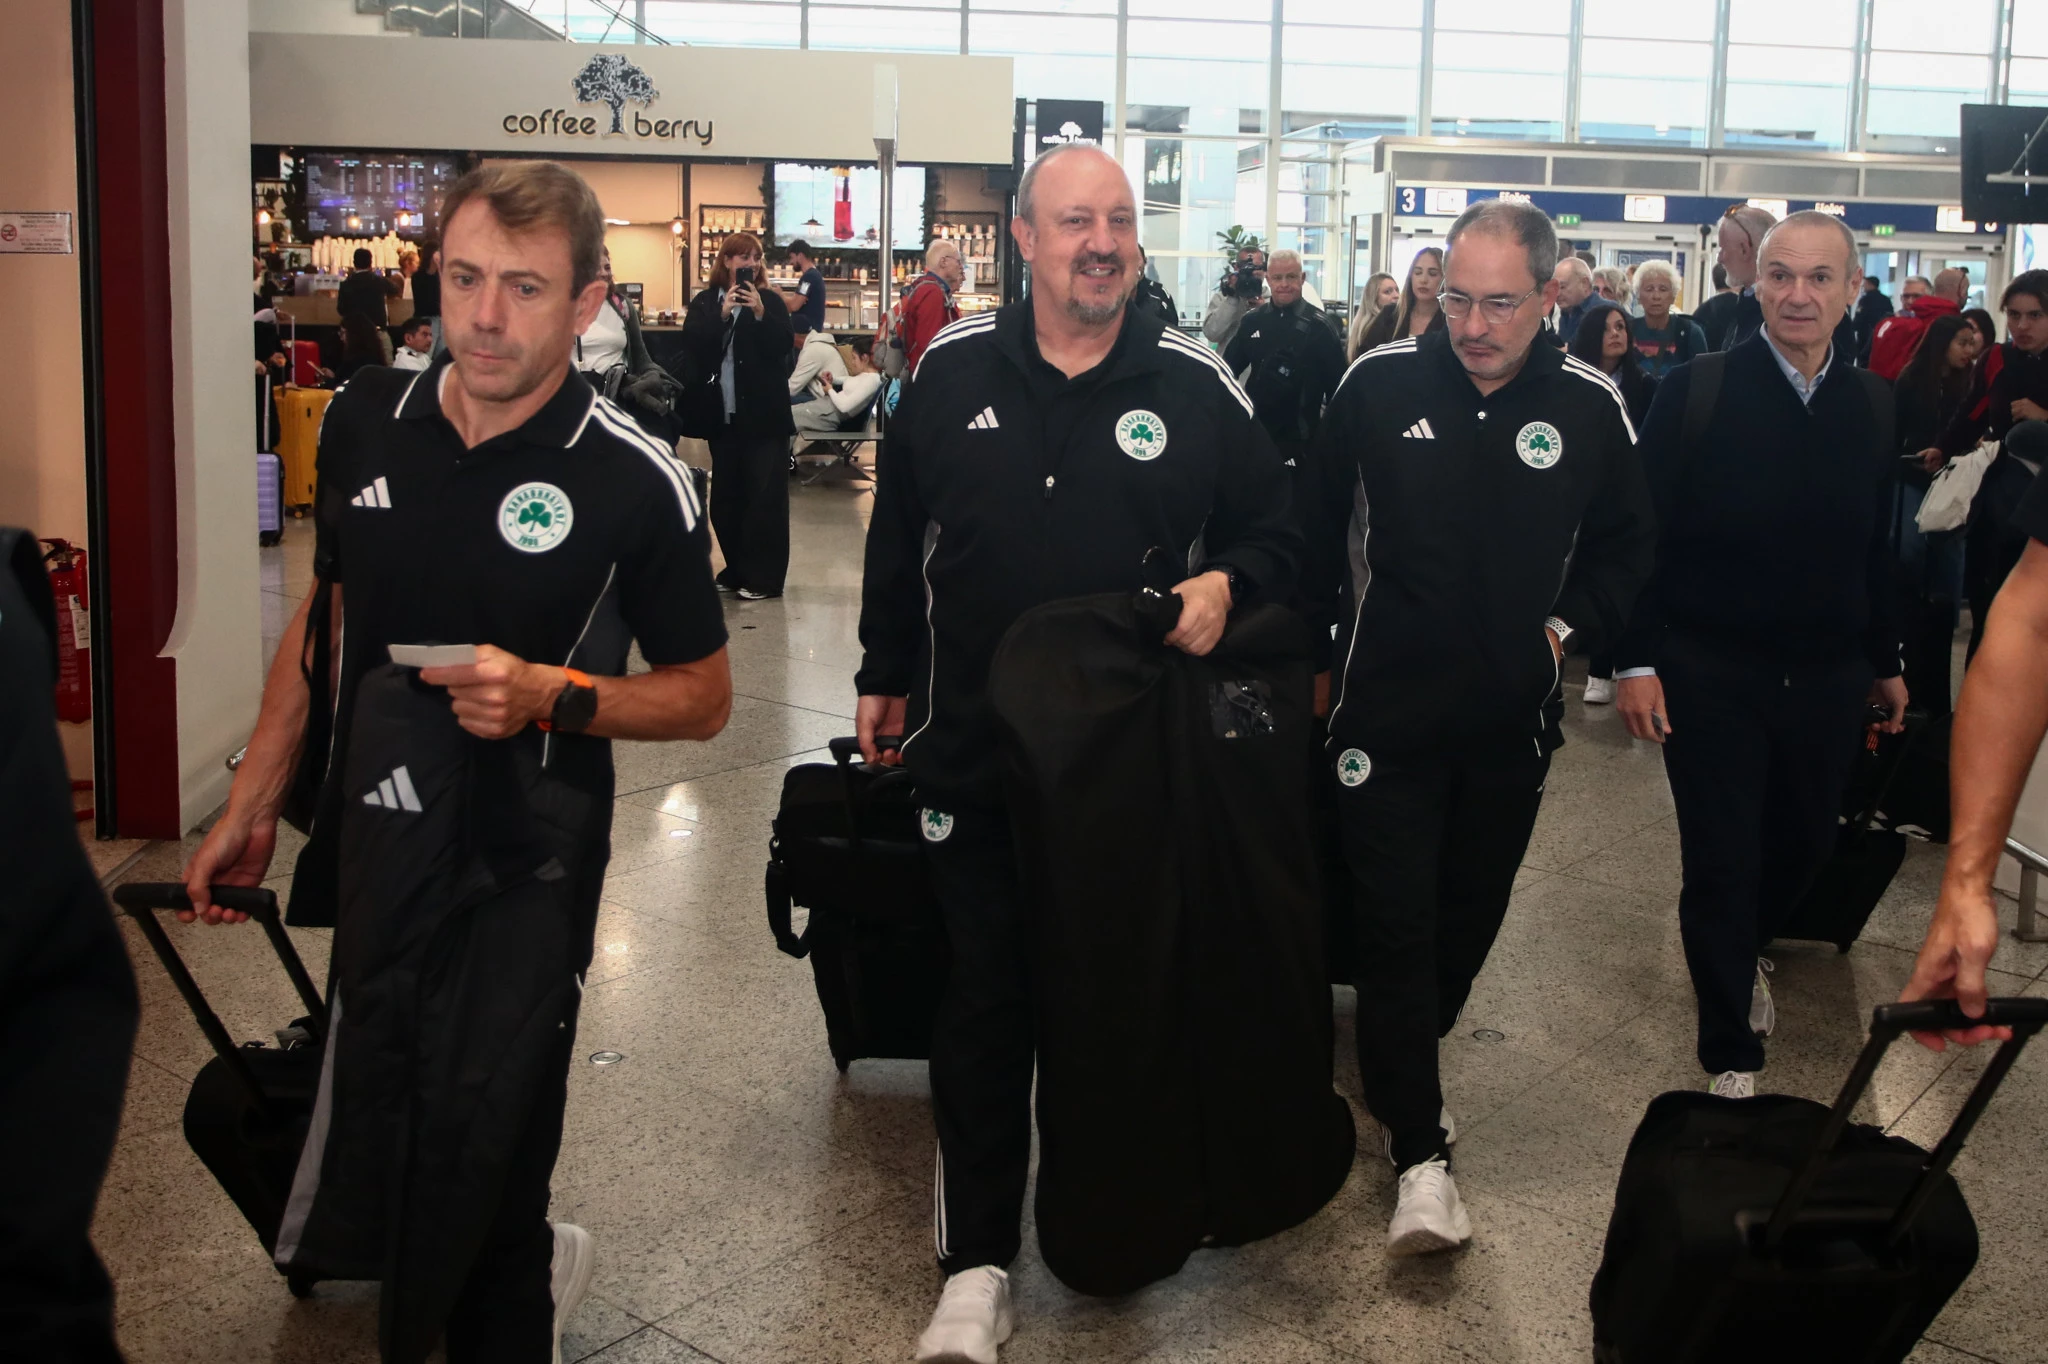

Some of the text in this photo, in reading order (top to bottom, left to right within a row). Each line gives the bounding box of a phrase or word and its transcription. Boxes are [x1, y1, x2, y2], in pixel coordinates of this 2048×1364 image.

[502, 108, 713, 146] coffee berry
[1402, 188, 1416, 213] 3
